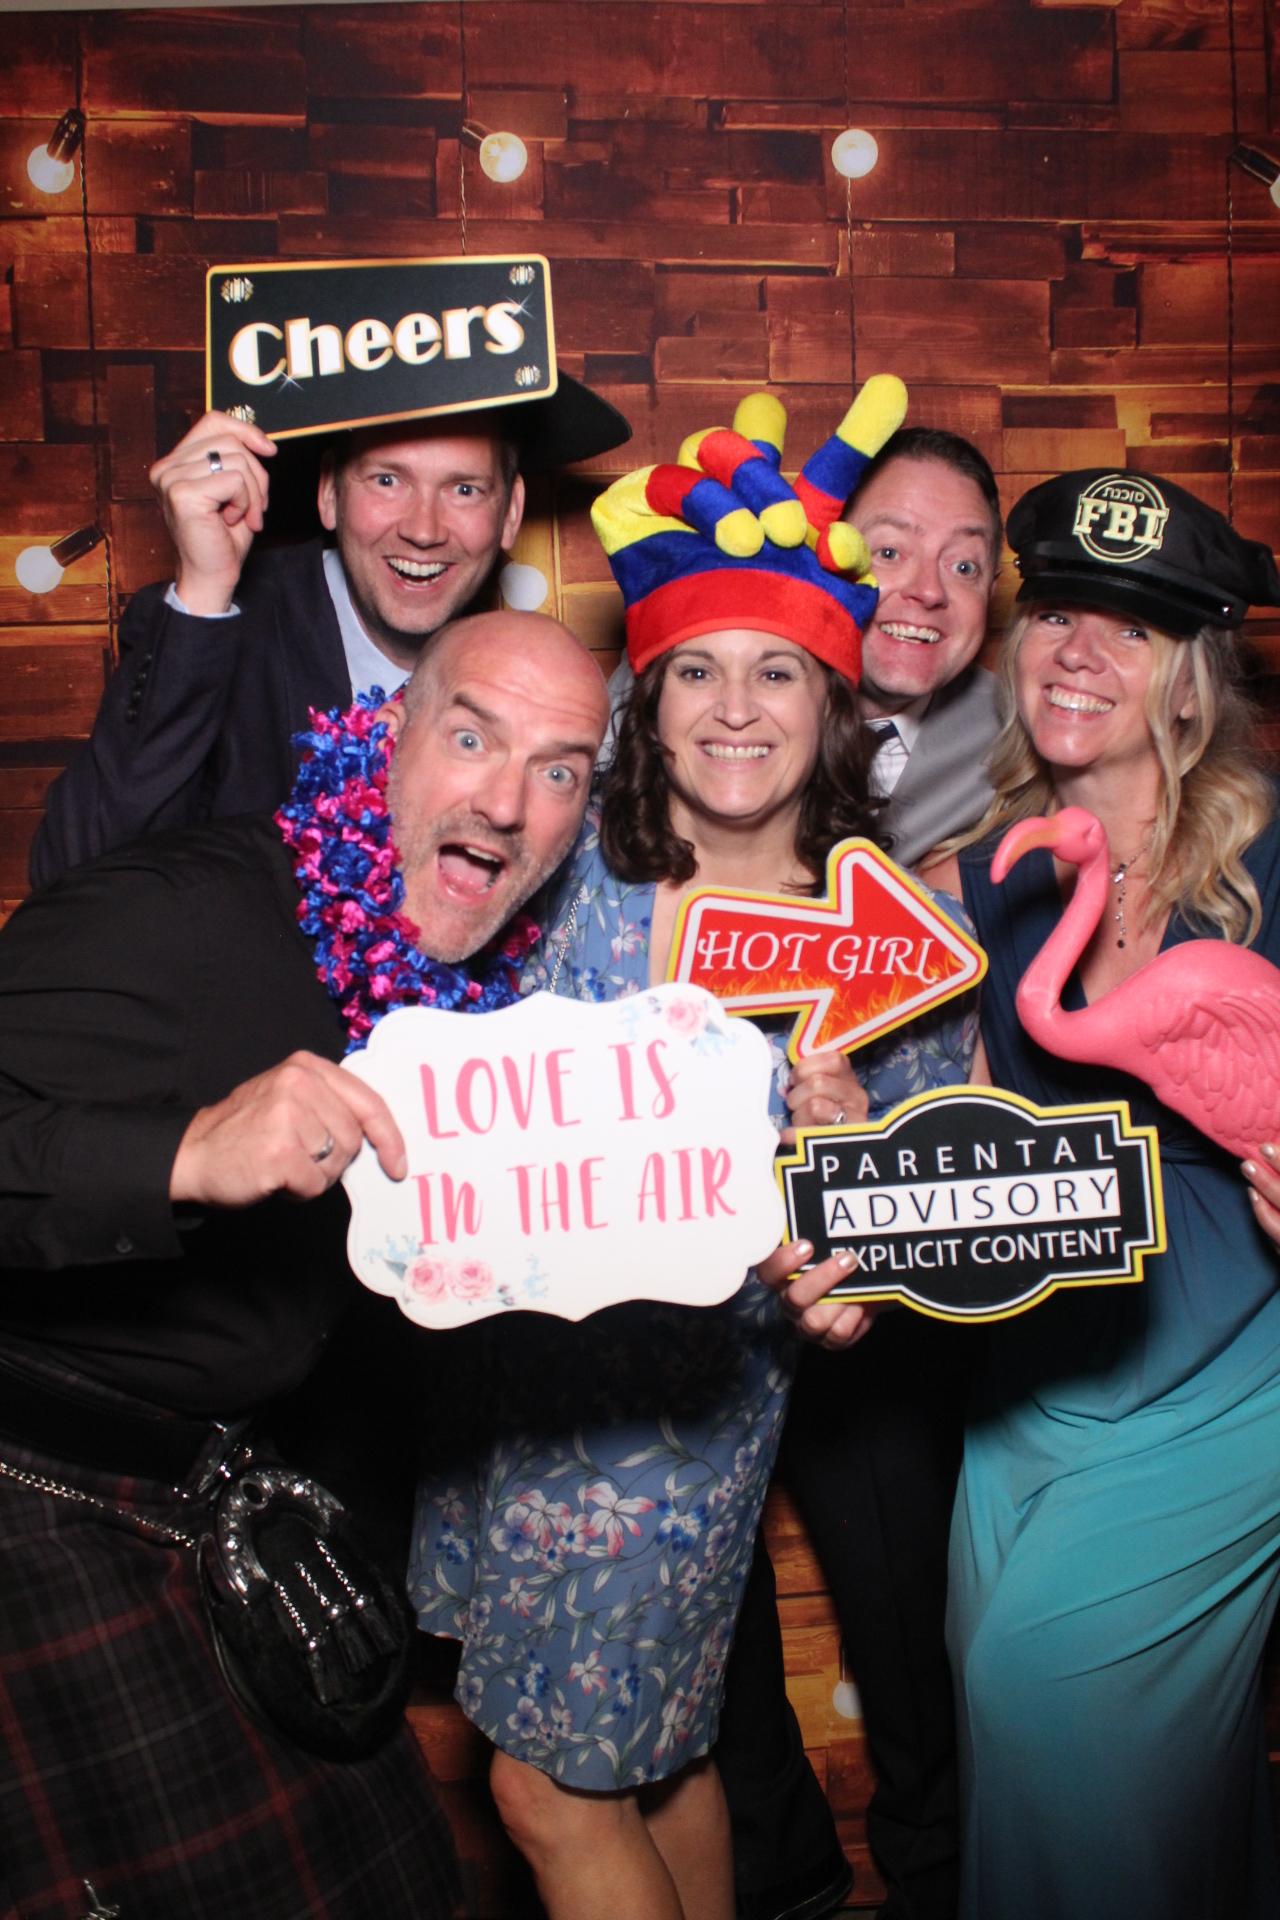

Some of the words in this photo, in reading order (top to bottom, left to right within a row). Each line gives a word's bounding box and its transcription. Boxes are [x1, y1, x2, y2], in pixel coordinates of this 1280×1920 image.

[228, 301, 526, 386] Cheers
[1072, 494, 1170, 550] FBI
[697, 930, 822, 972] HOT
[826, 935, 941, 986] GIRL
[419, 1052, 582, 1140] LOVE
[608, 1039, 680, 1121] IS
[821, 1133, 1115, 1183] PARENTAL
[506, 1156, 609, 1236] THE
[636, 1147, 737, 1224] AIR
[829, 1175, 1116, 1231] ADVISORY
[970, 1227, 1122, 1263] CONTENT
